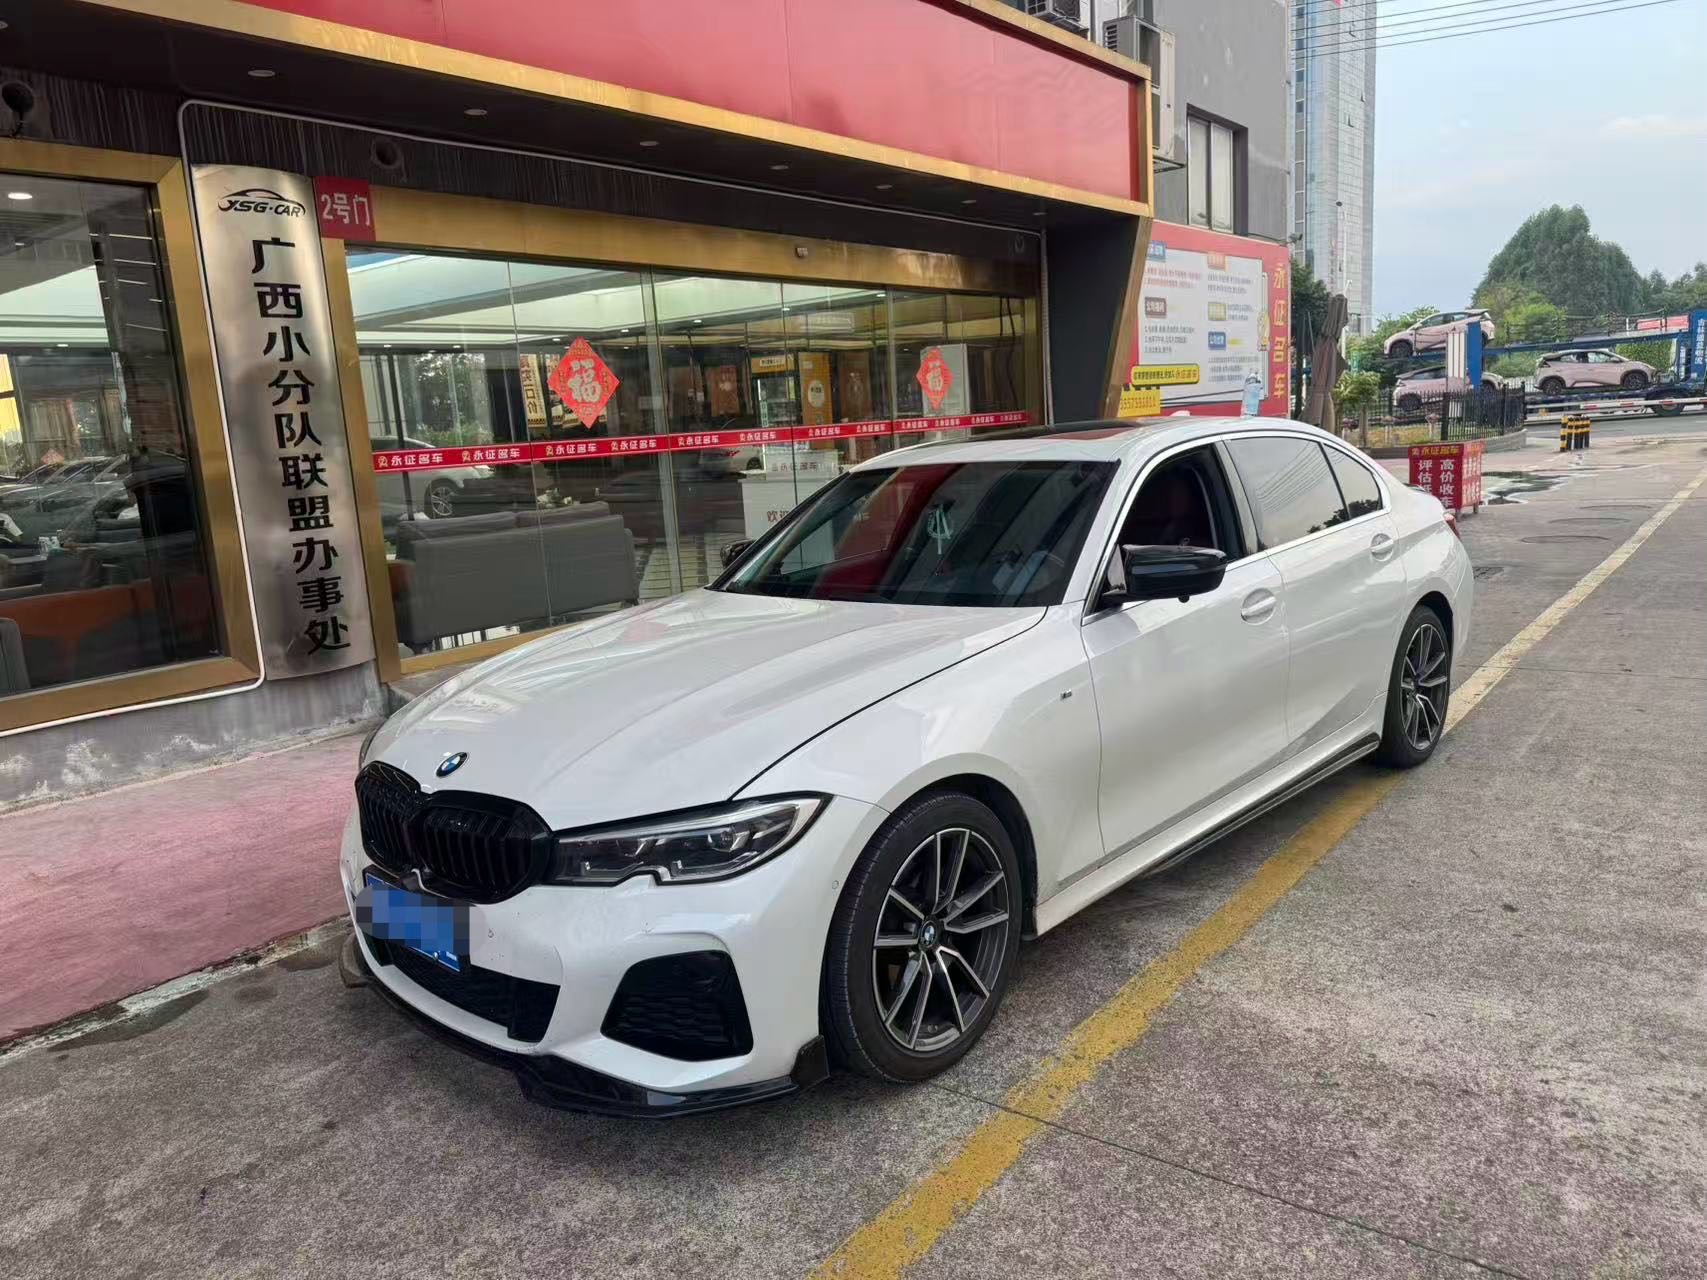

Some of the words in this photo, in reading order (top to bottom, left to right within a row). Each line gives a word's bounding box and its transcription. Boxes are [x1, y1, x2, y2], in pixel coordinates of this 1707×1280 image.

[321, 192, 371, 226] 2号门
[568, 358, 602, 403] 福
[251, 236, 352, 656] 广西小分队联盟办事处
[473, 448, 520, 461] 永征名车
[555, 443, 597, 455] 永征名车
[620, 439, 656, 451] 永征名车
[391, 453, 443, 466] 永征名车
[1440, 459, 1455, 508] 高价收车
